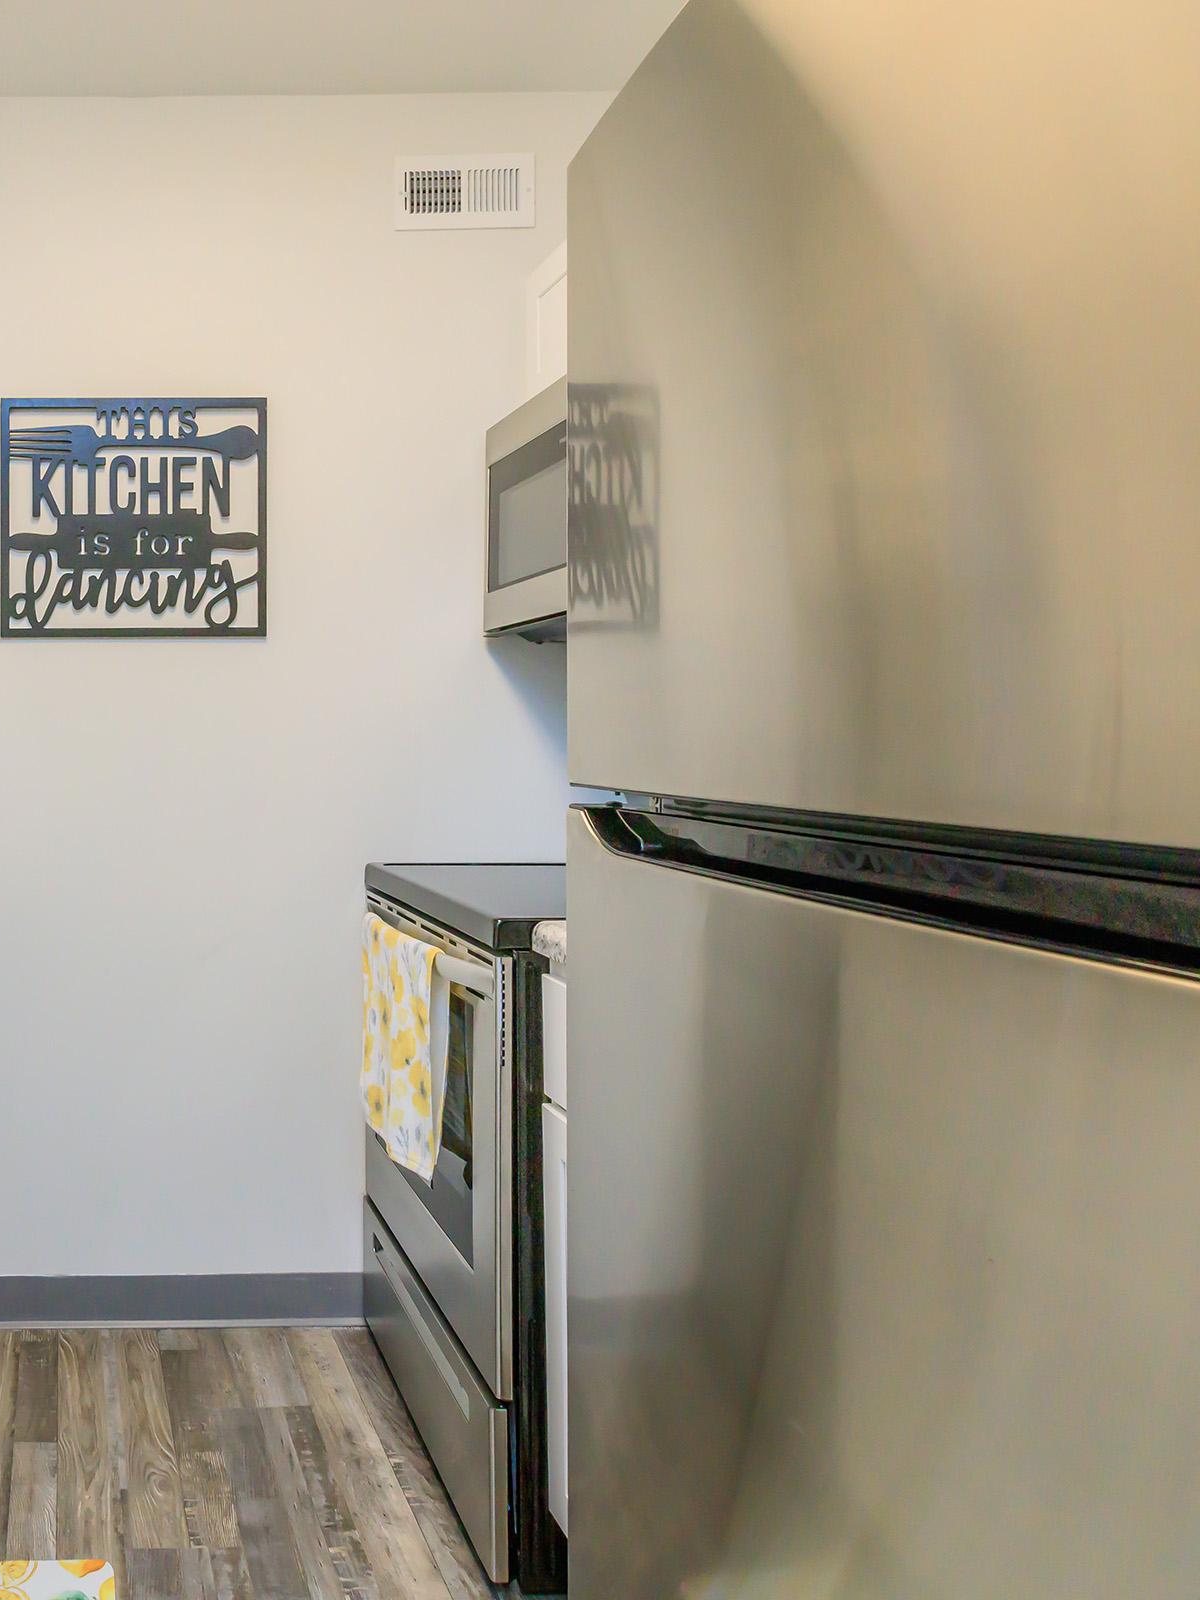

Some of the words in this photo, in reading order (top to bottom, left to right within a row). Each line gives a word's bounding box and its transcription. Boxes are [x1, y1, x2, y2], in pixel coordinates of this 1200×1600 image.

[97, 406, 199, 439] THIS
[32, 455, 230, 518] KITCHEN
[77, 526, 111, 556] is
[133, 526, 194, 556] for
[8, 549, 252, 629] dancing
